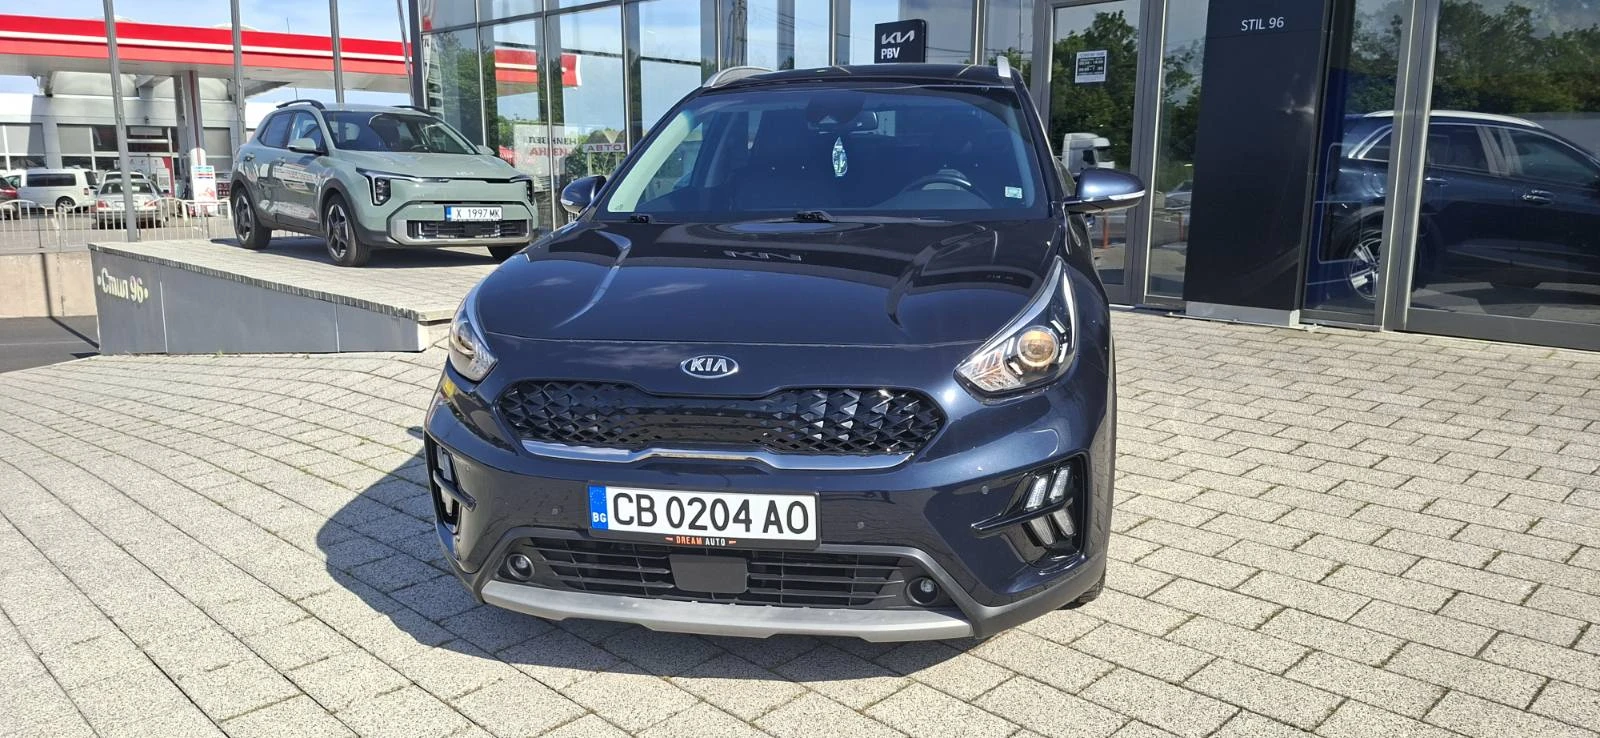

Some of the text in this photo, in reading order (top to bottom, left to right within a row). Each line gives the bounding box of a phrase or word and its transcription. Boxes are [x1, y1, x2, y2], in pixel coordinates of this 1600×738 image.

[1241, 16, 1285, 31] STIL 96
[881, 47, 900, 60] PBV
[467, 208, 488, 218] 1997
[130, 275, 144, 304] 96
[690, 357, 728, 373] KIA
[592, 512, 607, 523] BG
[612, 492, 809, 535] CB 0204 AO
[676, 535, 726, 547] DREAM AUTO
